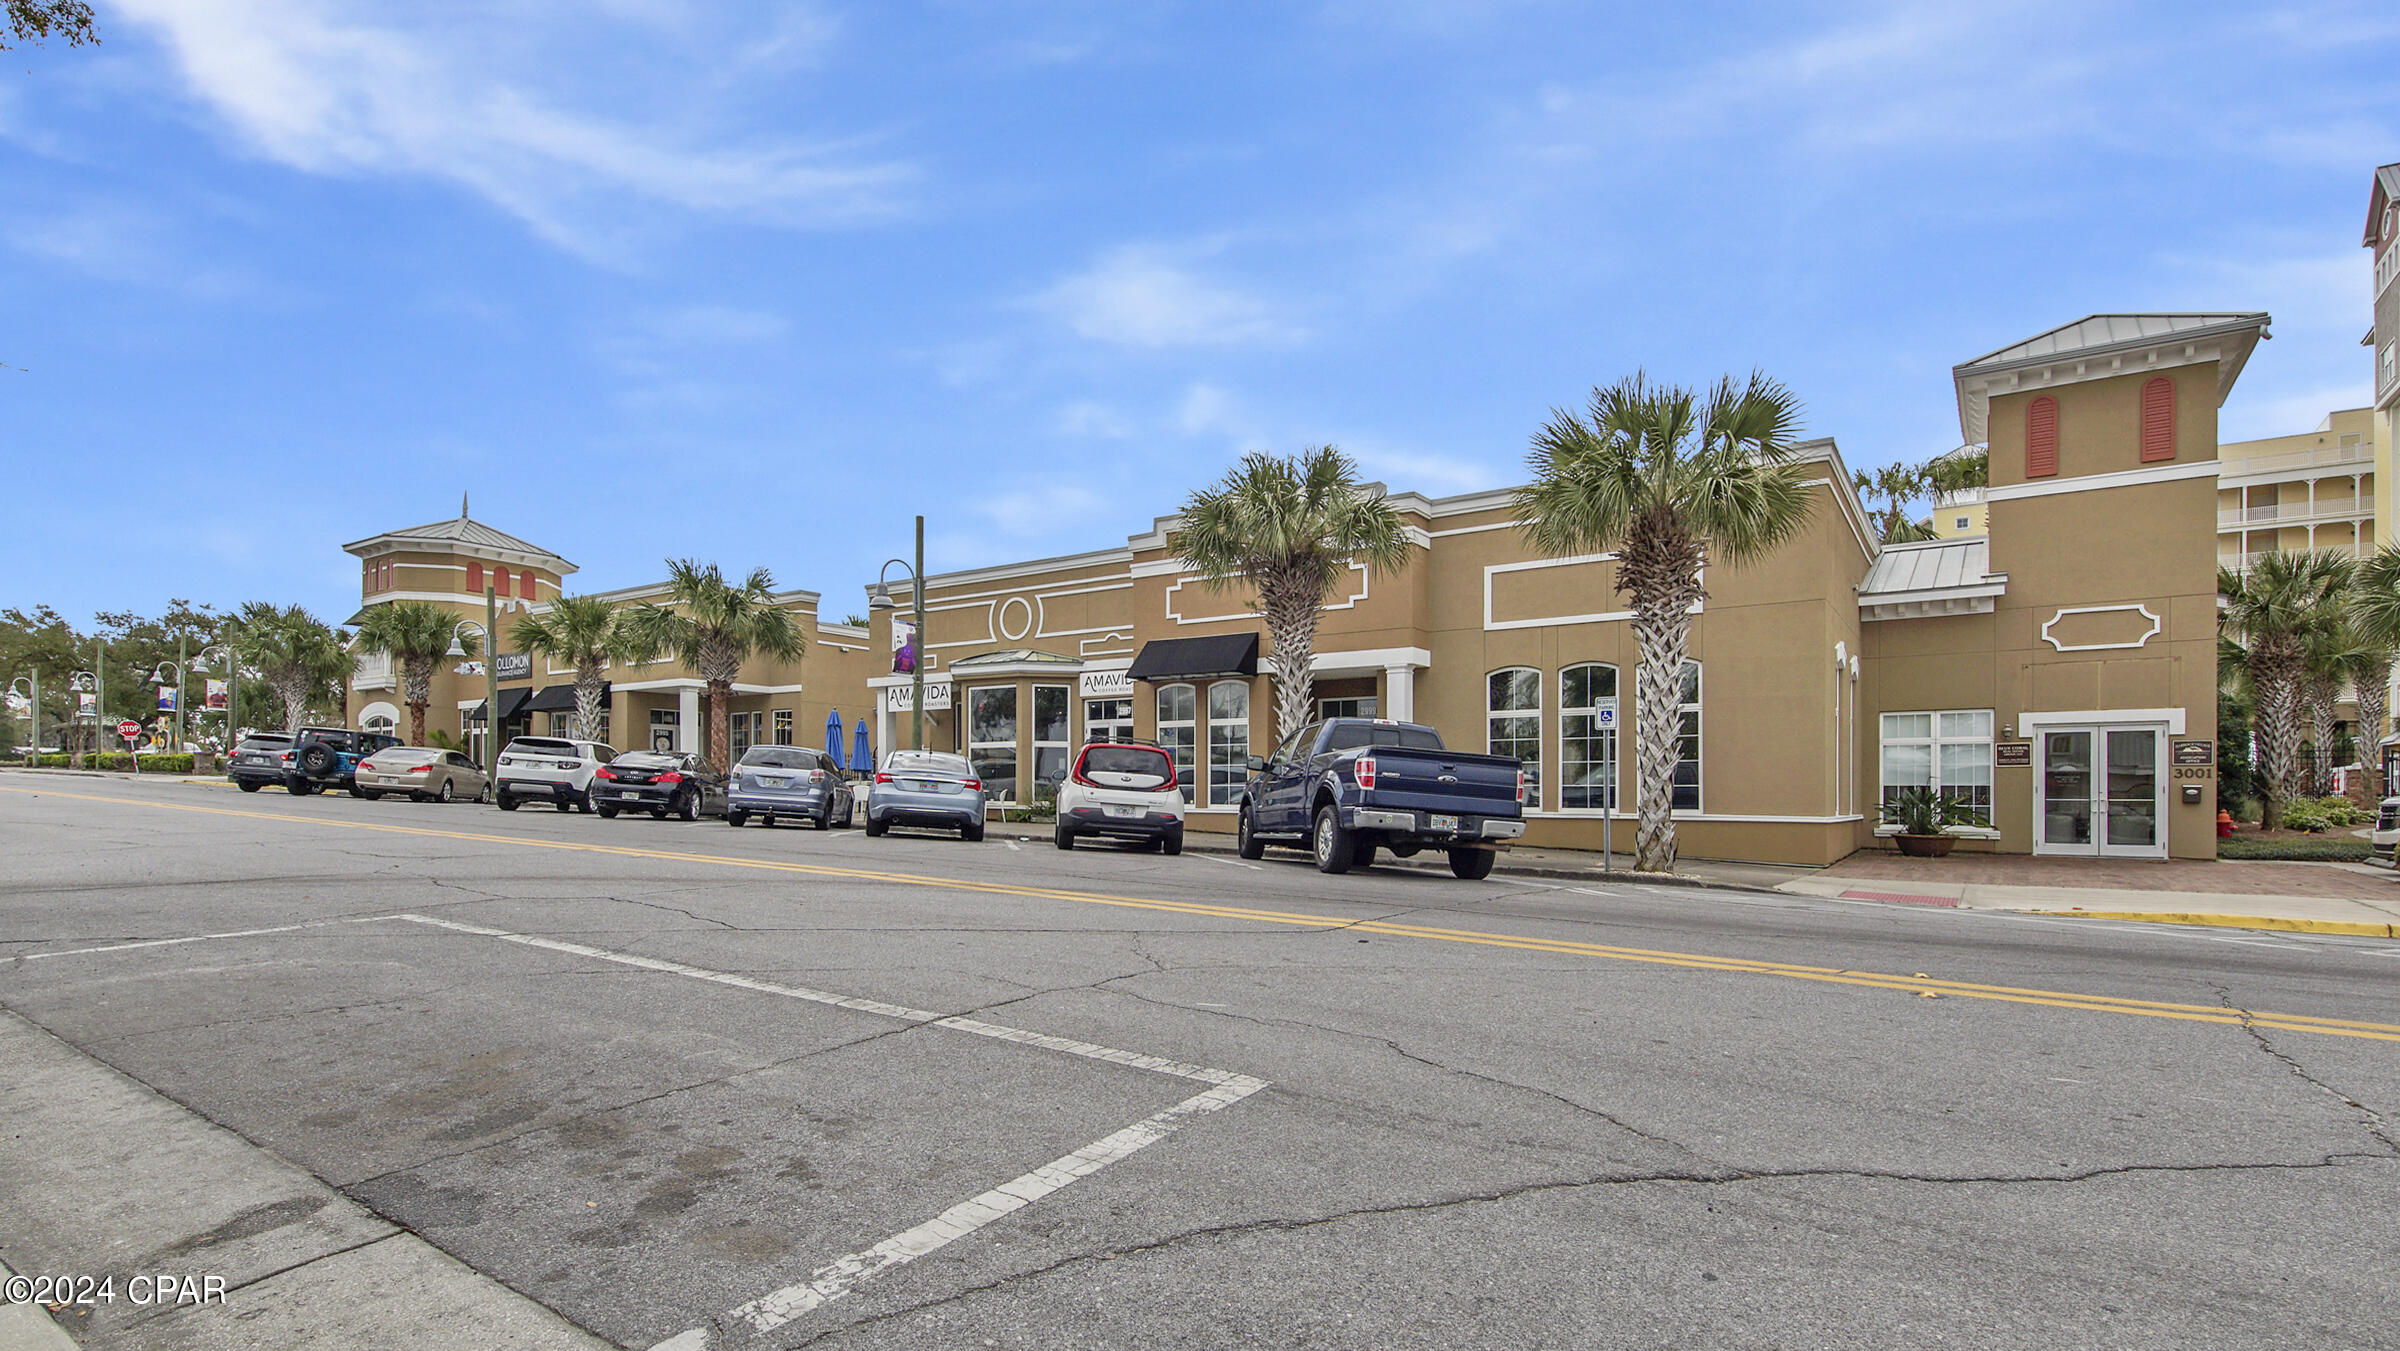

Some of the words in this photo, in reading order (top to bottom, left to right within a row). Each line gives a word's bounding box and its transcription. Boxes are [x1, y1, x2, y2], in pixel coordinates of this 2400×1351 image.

[496, 655, 529, 670] OLLOMON
[1085, 673, 1134, 692] AMAVID
[890, 685, 949, 707] AMIDA
[2174, 768, 2212, 779] 3001
